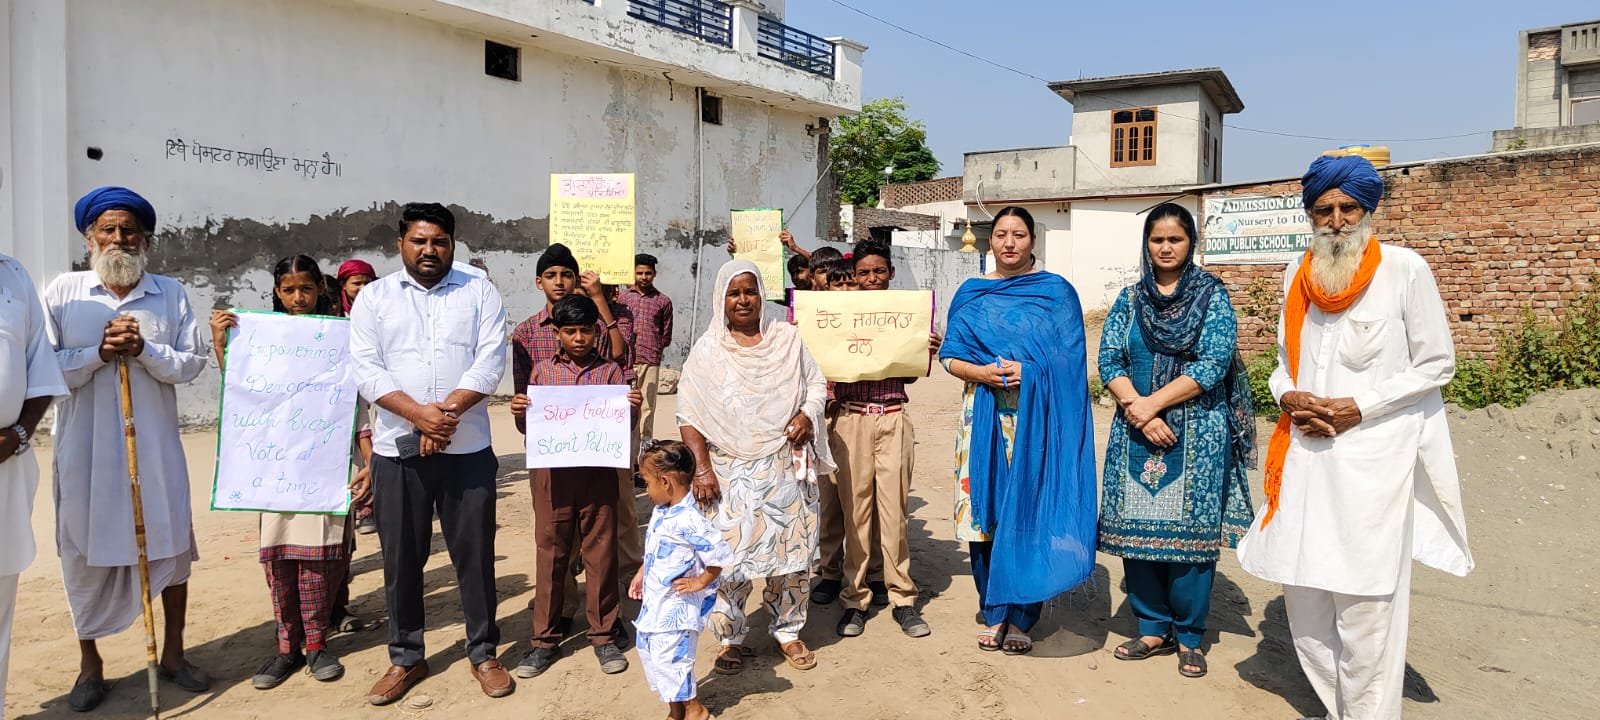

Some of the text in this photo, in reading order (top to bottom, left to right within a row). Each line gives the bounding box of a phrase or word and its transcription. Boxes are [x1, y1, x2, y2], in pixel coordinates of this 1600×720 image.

[1224, 197, 1305, 213] ADMISSION OP
[1238, 217, 1274, 228] Nursery
[1277, 216, 1288, 225] to
[1206, 237, 1228, 252] DOON
[1229, 236, 1257, 250] PUBLIC
[1259, 235, 1294, 251] SCHOOL,
[1295, 234, 1313, 248] PAT
[816, 307, 843, 329] ਚੋਣ
[247, 329, 345, 372] Empowering
[246, 375, 344, 405] Democracy
[543, 404, 577, 426] Stop
[246, 440, 318, 461] Vote at
[537, 430, 623, 460] Start Polling
[252, 472, 320, 495] a time
